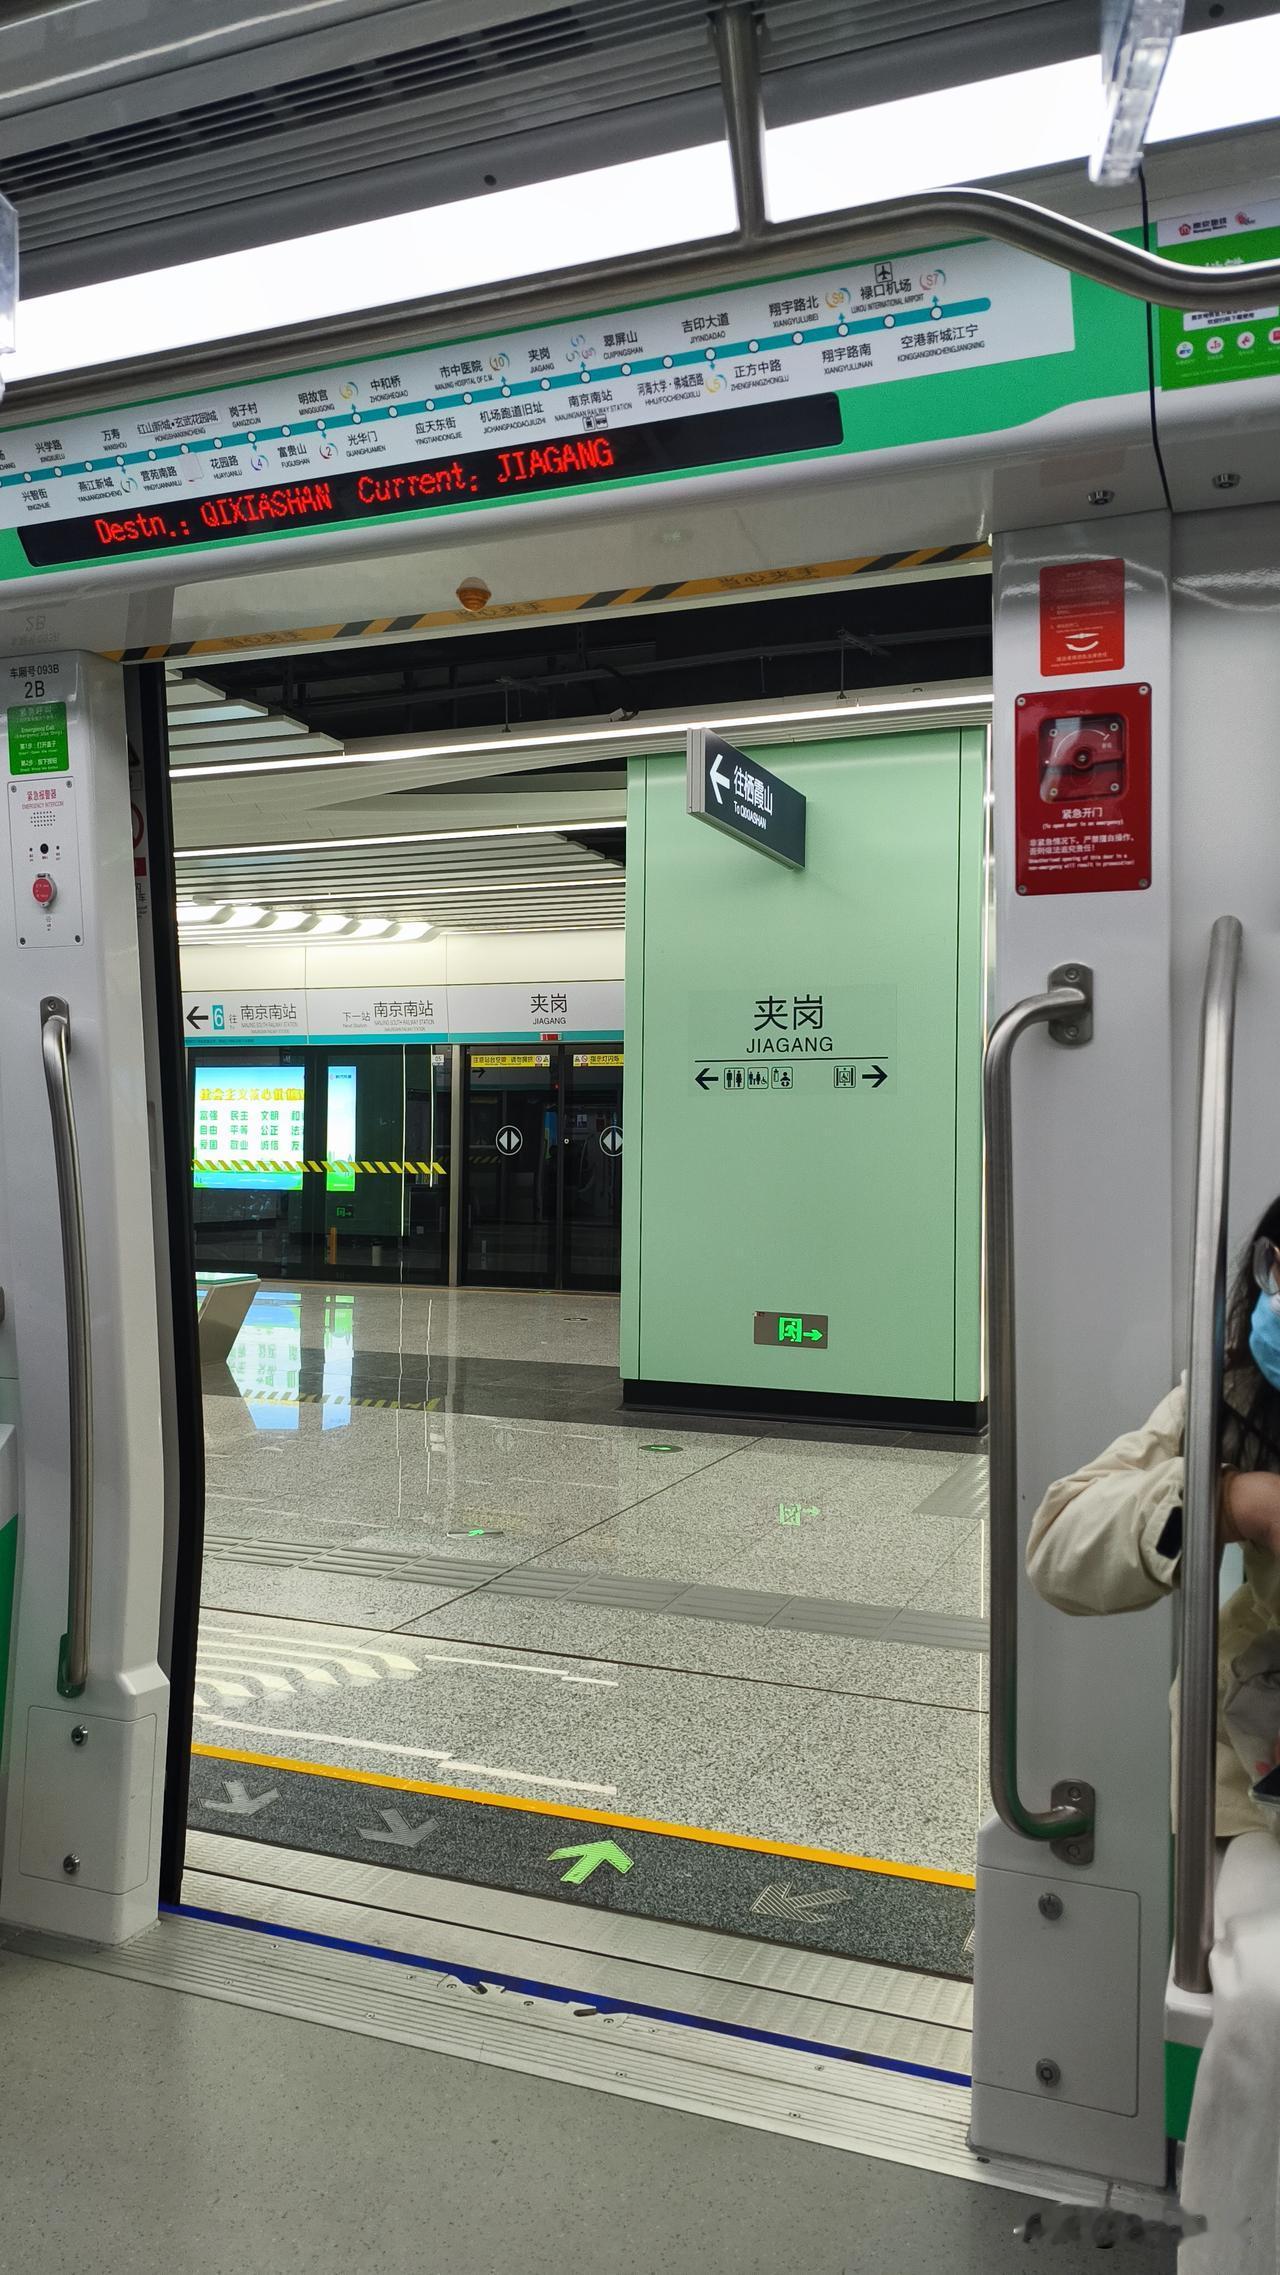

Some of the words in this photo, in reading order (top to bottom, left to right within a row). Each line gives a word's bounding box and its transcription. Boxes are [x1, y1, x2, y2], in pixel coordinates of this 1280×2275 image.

[860, 278, 912, 300] 禄口机场
[769, 296, 819, 317] 翔宇路北
[681, 312, 730, 334] 吉印大道
[603, 330, 638, 348] 翠屏山
[900, 323, 979, 349] 空港新城江宁
[528, 347, 551, 363] 夹岗
[822, 343, 872, 363] 翔宇路南
[440, 360, 483, 379] 市中医院
[734, 358, 782, 379] 正方中路
[370, 374, 401, 392] 中和桥
[298, 389, 328, 405] 明故宫
[568, 389, 613, 408] 南京南站
[229, 402, 258, 418] 岗子村
[480, 401, 544, 423] 机场跑道旧址
[415, 416, 456, 434] 应天东街
[101, 428, 120, 441] 万寿
[347, 430, 378, 446] 光华门
[34, 439, 62, 453] 兴学路
[277, 443, 307, 458] 富贵山
[210, 455, 239, 470] 花园路
[140, 466, 177, 482] 营苑南路
[22, 488, 48, 502] 兴智街
[94, 513, 191, 544] Destn.:
[200, 482, 333, 528] QIXIASHAN
[357, 462, 479, 504] Current:
[497, 436, 614, 483] JIAGANG
[24, 680, 45, 698] 2B
[734, 765, 773, 816] 往栖霞山
[733, 800, 740, 815] To
[1062, 807, 1103, 819] 紧急开门
[240, 1003, 297, 1020] 南京南站
[373, 1000, 434, 1018] 南京南站
[530, 992, 568, 1014] 夹岗
[214, 1007, 224, 1027] 6
[229, 1013, 238, 1024] 往
[342, 1011, 371, 1022] 下一站
[533, 1016, 567, 1025] JIAGANG
[754, 994, 823, 1031] 夹岗
[746, 1036, 833, 1053] JIAGANG
[200, 1110, 218, 1121] 富强
[230, 1110, 248, 1121] 民主
[261, 1110, 279, 1121] 文明
[200, 1125, 218, 1135] 自由
[230, 1125, 248, 1136] 平等
[261, 1125, 279, 1136] 公正
